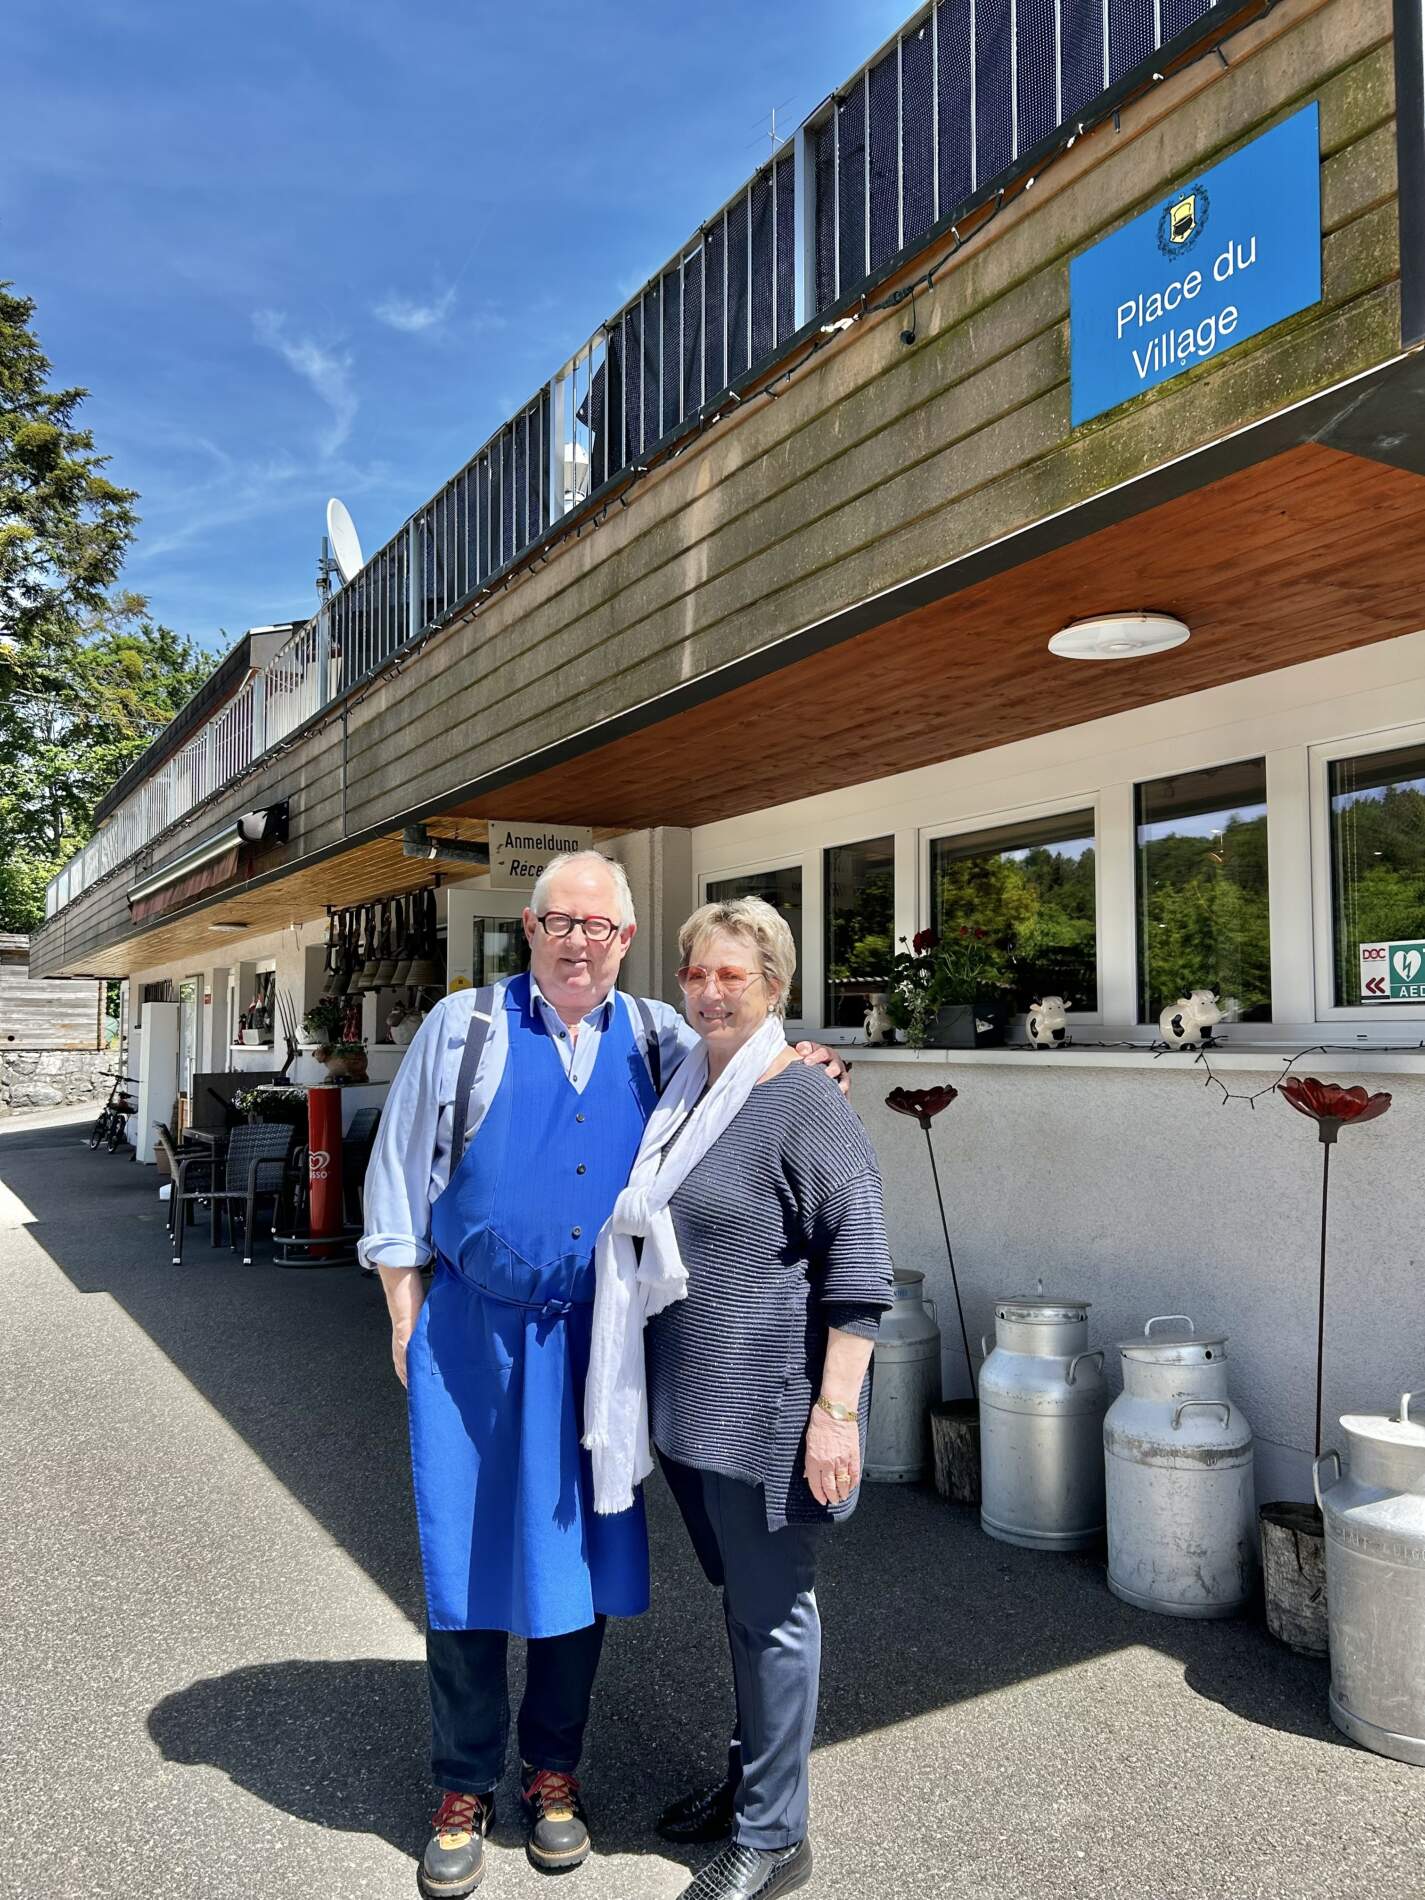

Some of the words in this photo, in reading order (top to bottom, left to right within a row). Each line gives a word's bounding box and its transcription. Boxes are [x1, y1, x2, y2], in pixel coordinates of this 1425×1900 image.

[1116, 270, 1202, 339] Place
[1213, 235, 1257, 282] du
[1131, 305, 1238, 379] Village
[505, 831, 578, 852] Anmeldung
[509, 859, 544, 877] Réce
[1362, 948, 1386, 960] DOC
